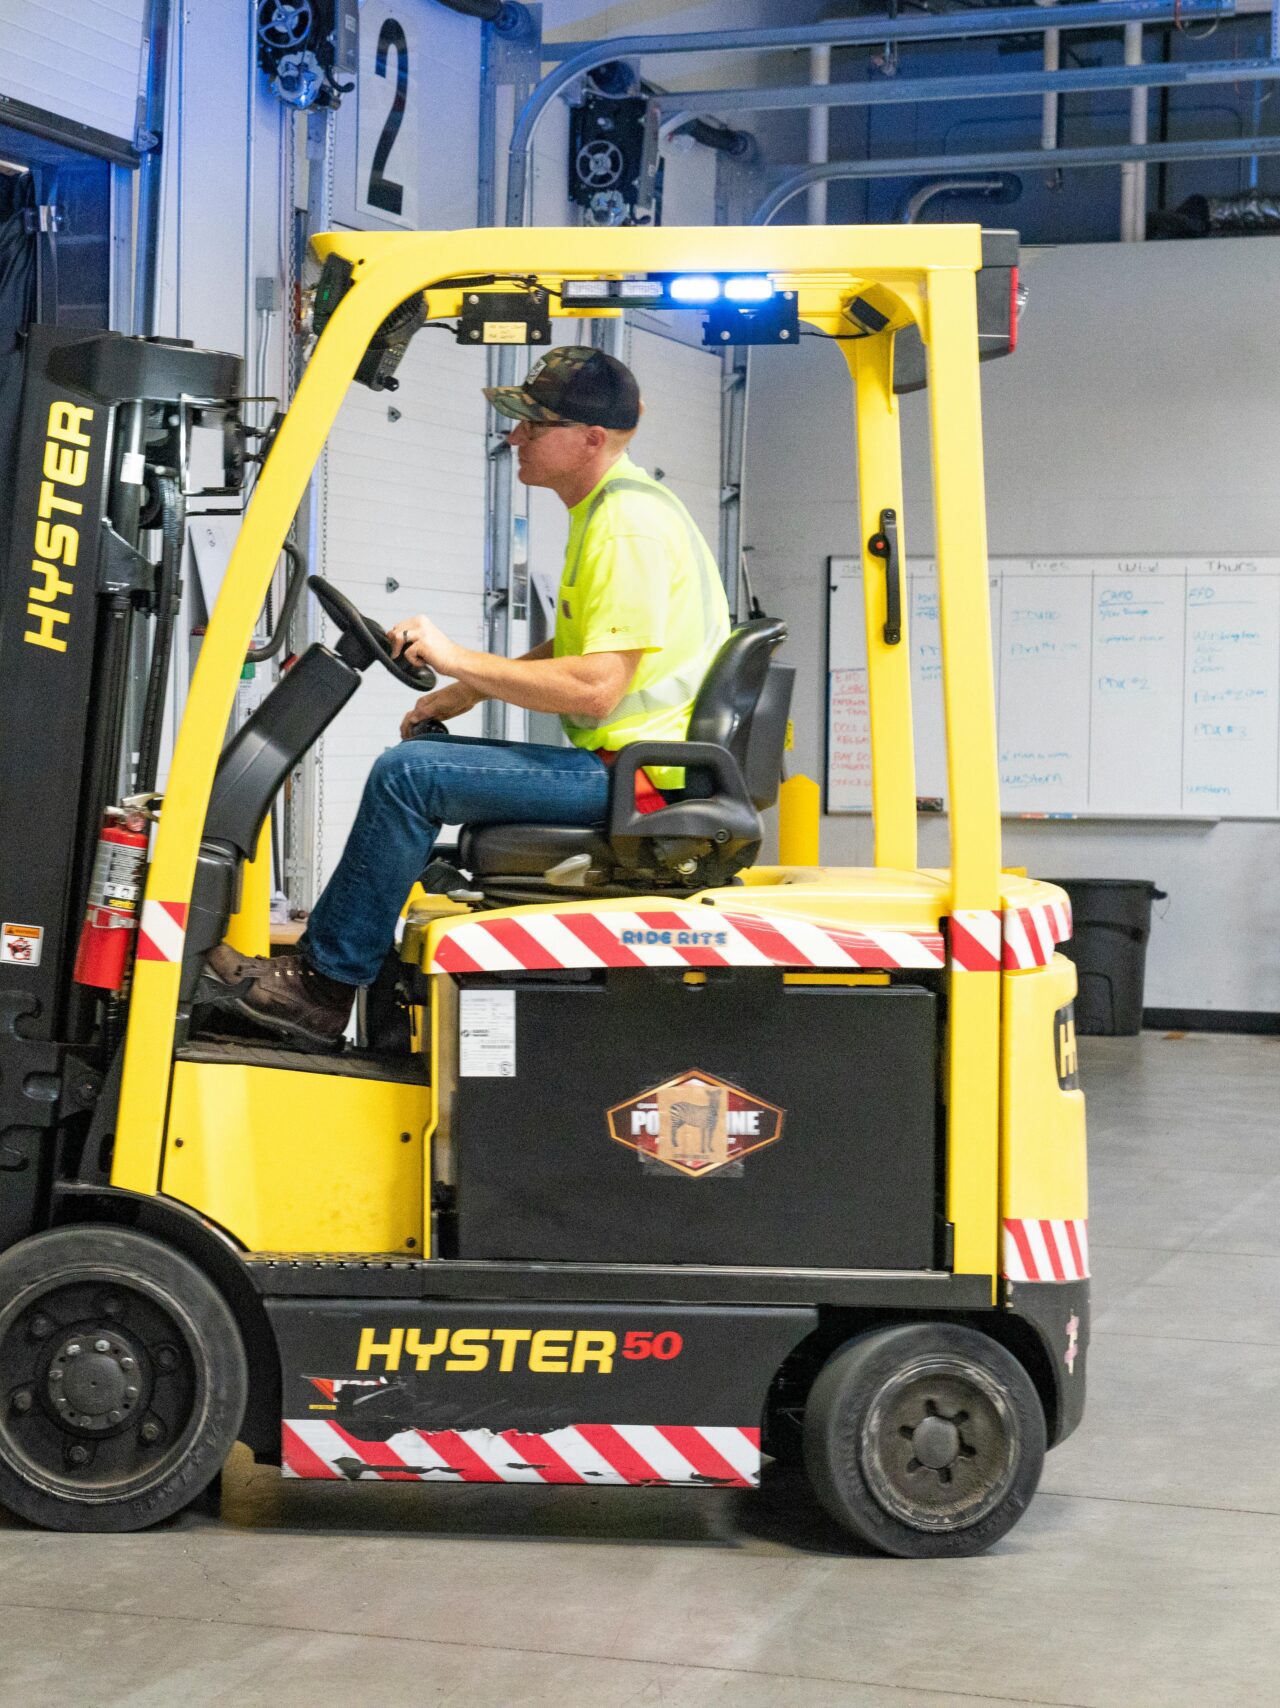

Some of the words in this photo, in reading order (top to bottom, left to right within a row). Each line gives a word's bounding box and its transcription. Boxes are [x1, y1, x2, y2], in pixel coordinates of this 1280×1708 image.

[367, 18, 408, 216] 2
[24, 401, 94, 653] HYSTER
[622, 930, 671, 945] RIDE
[356, 1328, 617, 1374] HYSTER
[622, 1330, 683, 1360] 50
